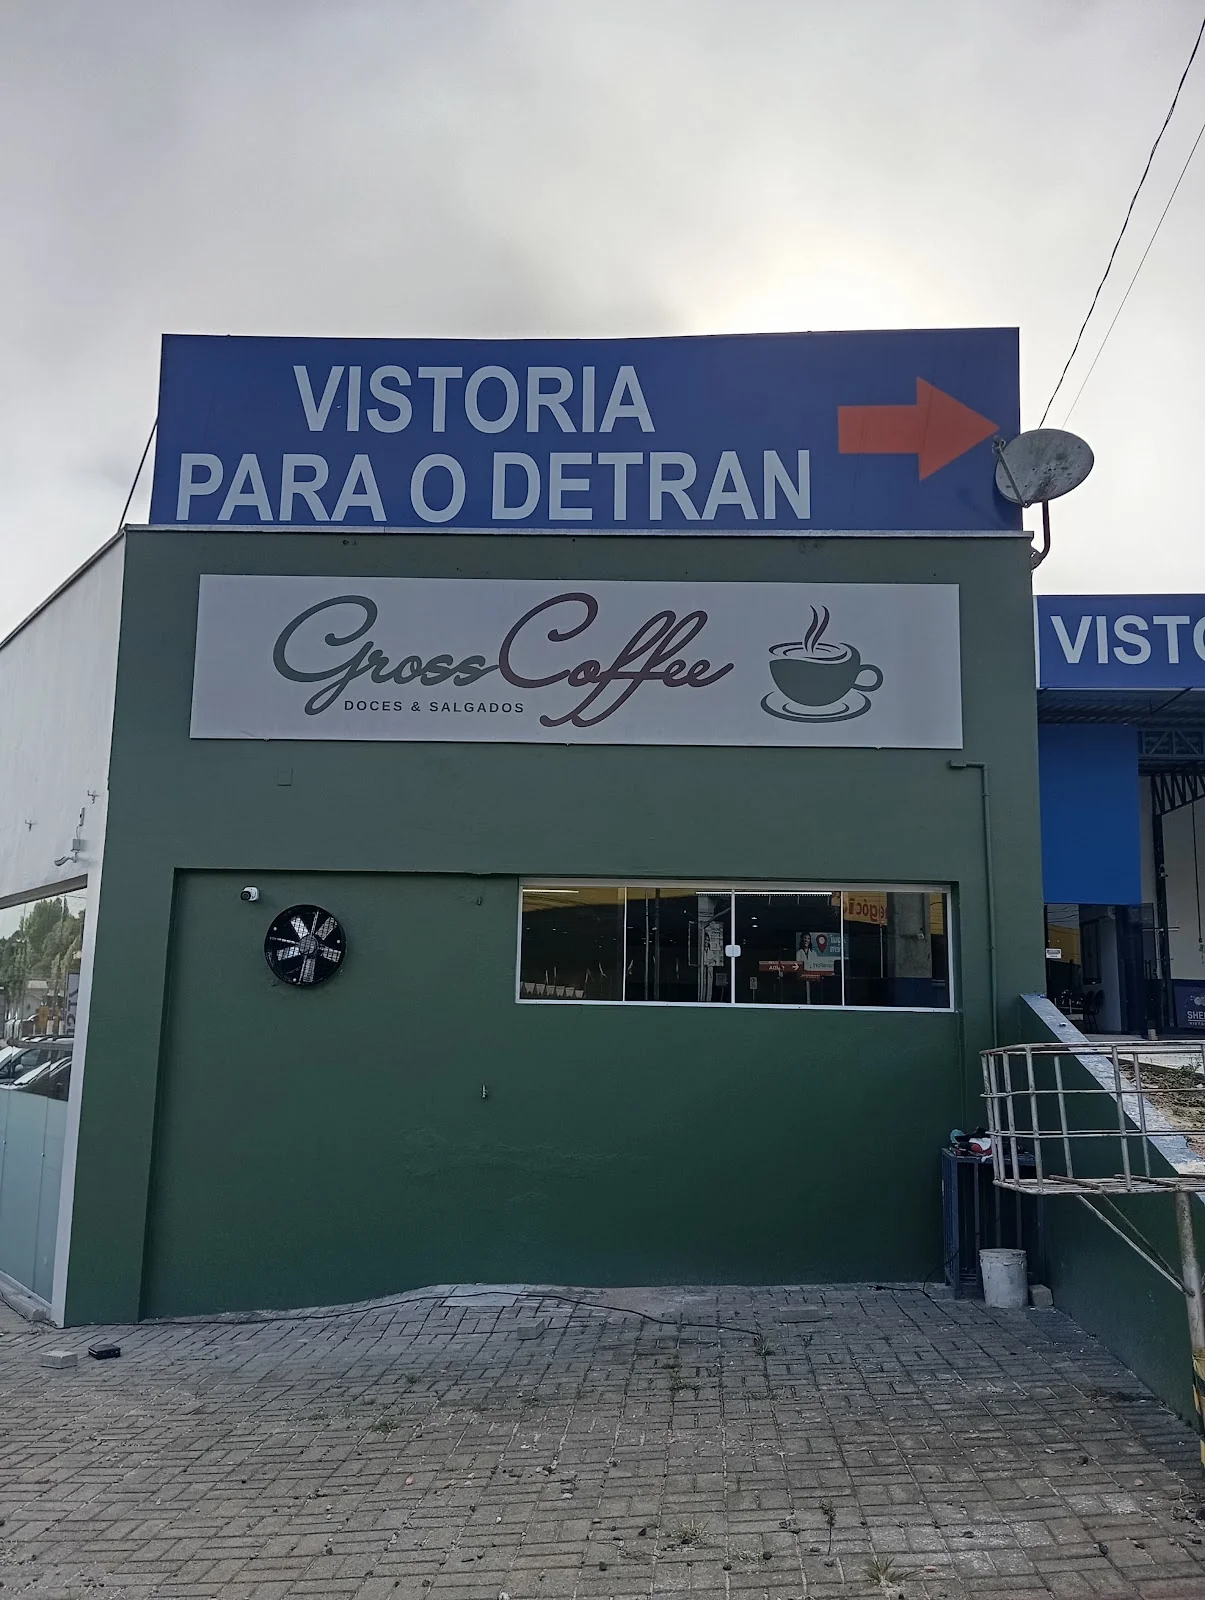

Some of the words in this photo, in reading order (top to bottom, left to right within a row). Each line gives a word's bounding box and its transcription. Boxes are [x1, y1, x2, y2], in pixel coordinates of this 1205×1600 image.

[293, 364, 656, 433] VISTORIA
[176, 453, 388, 522] PARA
[410, 453, 466, 523] O
[491, 449, 811, 521] DETRAN
[273, 595, 499, 715] Gross
[499, 592, 735, 728] Coffee
[344, 700, 403, 712] DOCES
[410, 701, 421, 712] &
[429, 701, 524, 713] SALGADOS
[1187, 1010, 1205, 1020] SHE
